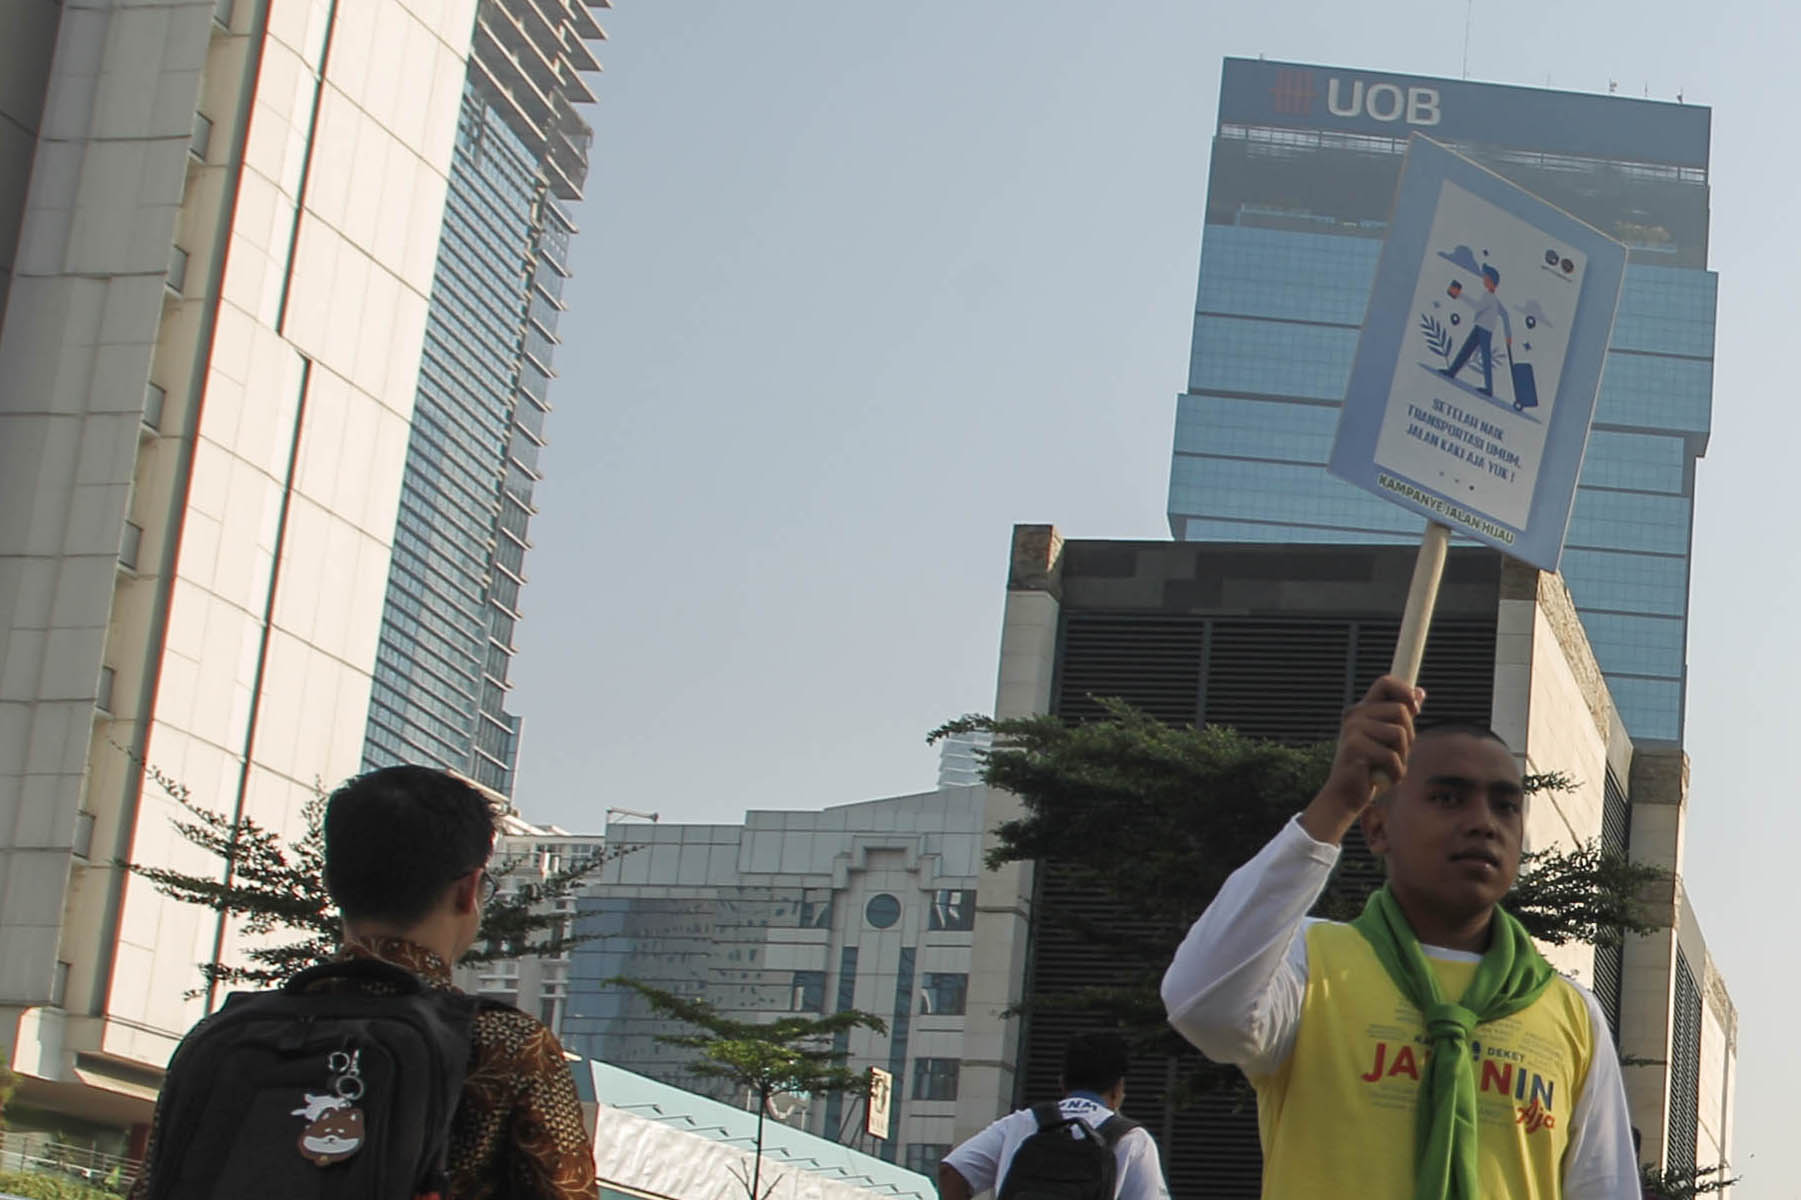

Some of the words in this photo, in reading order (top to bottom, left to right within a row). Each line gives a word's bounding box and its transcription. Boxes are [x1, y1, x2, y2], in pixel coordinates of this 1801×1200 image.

[1328, 78, 1441, 126] UOB
[1407, 404, 1485, 451] TRANSPORTASI
[1432, 397, 1478, 429] SETELAH
[1480, 421, 1504, 441] NAIK
[1406, 423, 1439, 447] JALAN
[1440, 437, 1464, 459] KAKI
[1466, 451, 1485, 468] AJA
[1488, 461, 1508, 481] YUK
[1378, 474, 1443, 513] KAMPANYE
[1445, 503, 1481, 530] JALAN
[1482, 521, 1515, 545] HIJAU
[1487, 1046, 1525, 1063] DEKET
